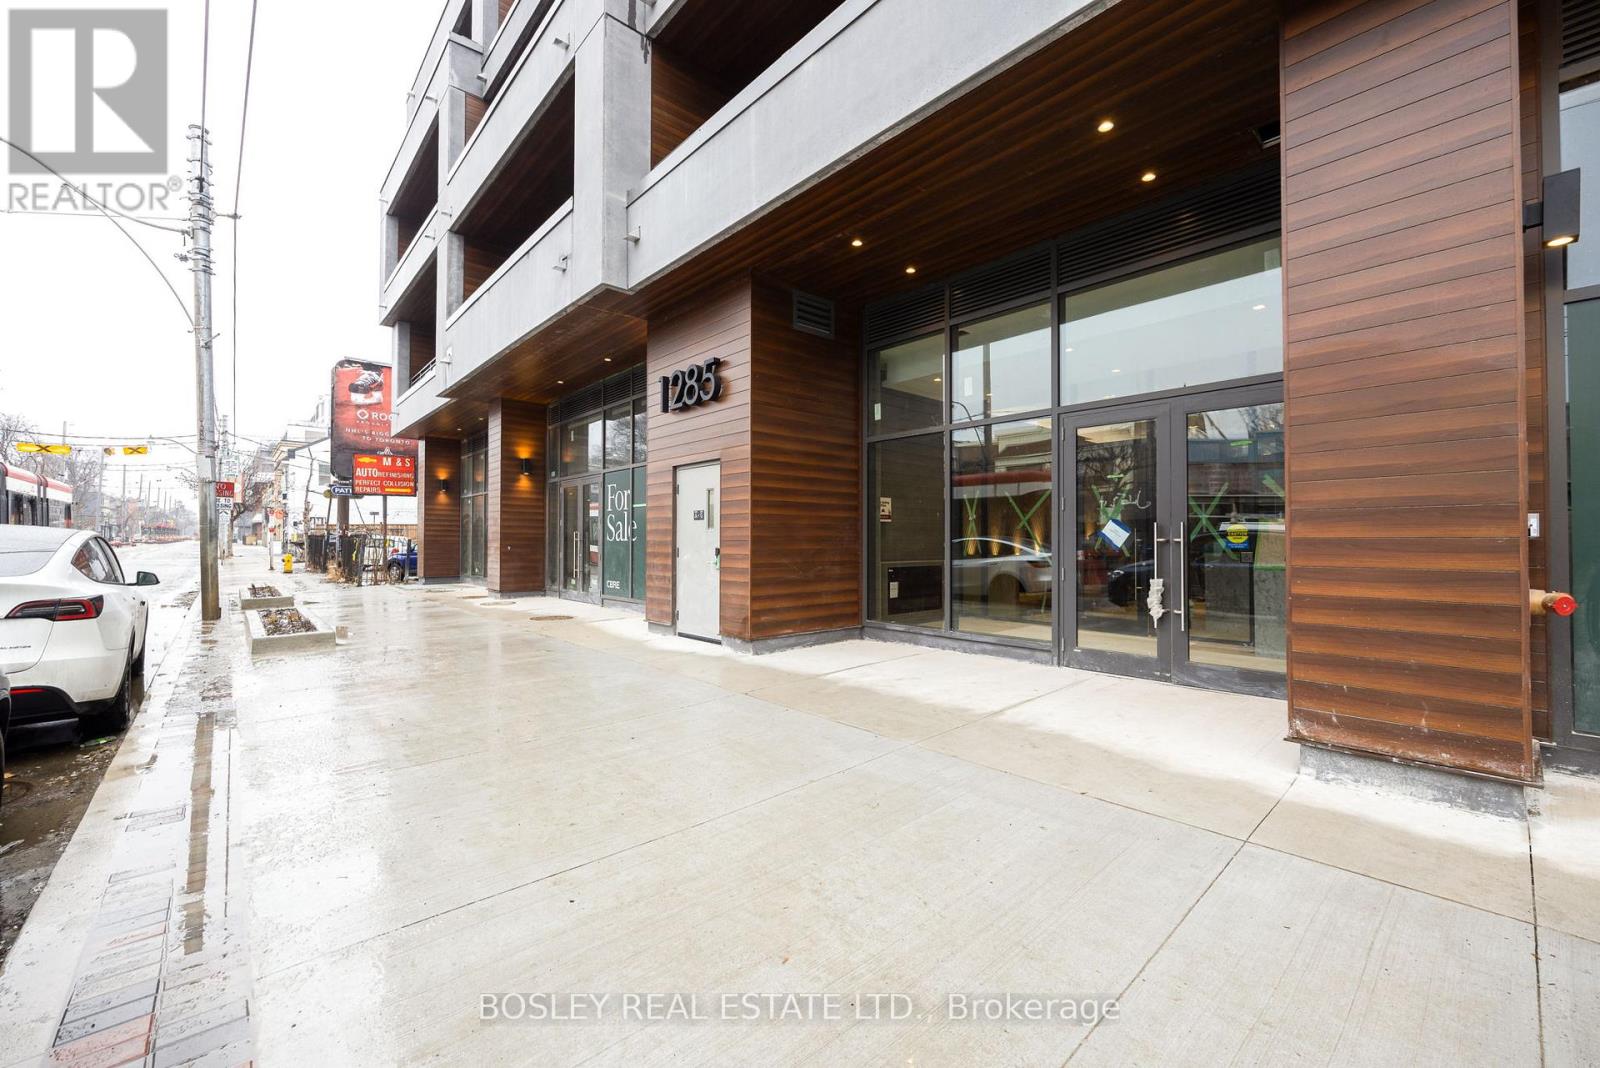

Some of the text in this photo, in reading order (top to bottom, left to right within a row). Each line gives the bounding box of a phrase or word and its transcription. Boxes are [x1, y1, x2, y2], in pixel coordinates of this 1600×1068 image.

[658, 357, 721, 413] 1285
[382, 457, 411, 467] M & S
[355, 467, 378, 477] AUTO
[607, 483, 631, 511] For
[606, 511, 637, 541] Sale
[606, 580, 621, 589] CBRE
